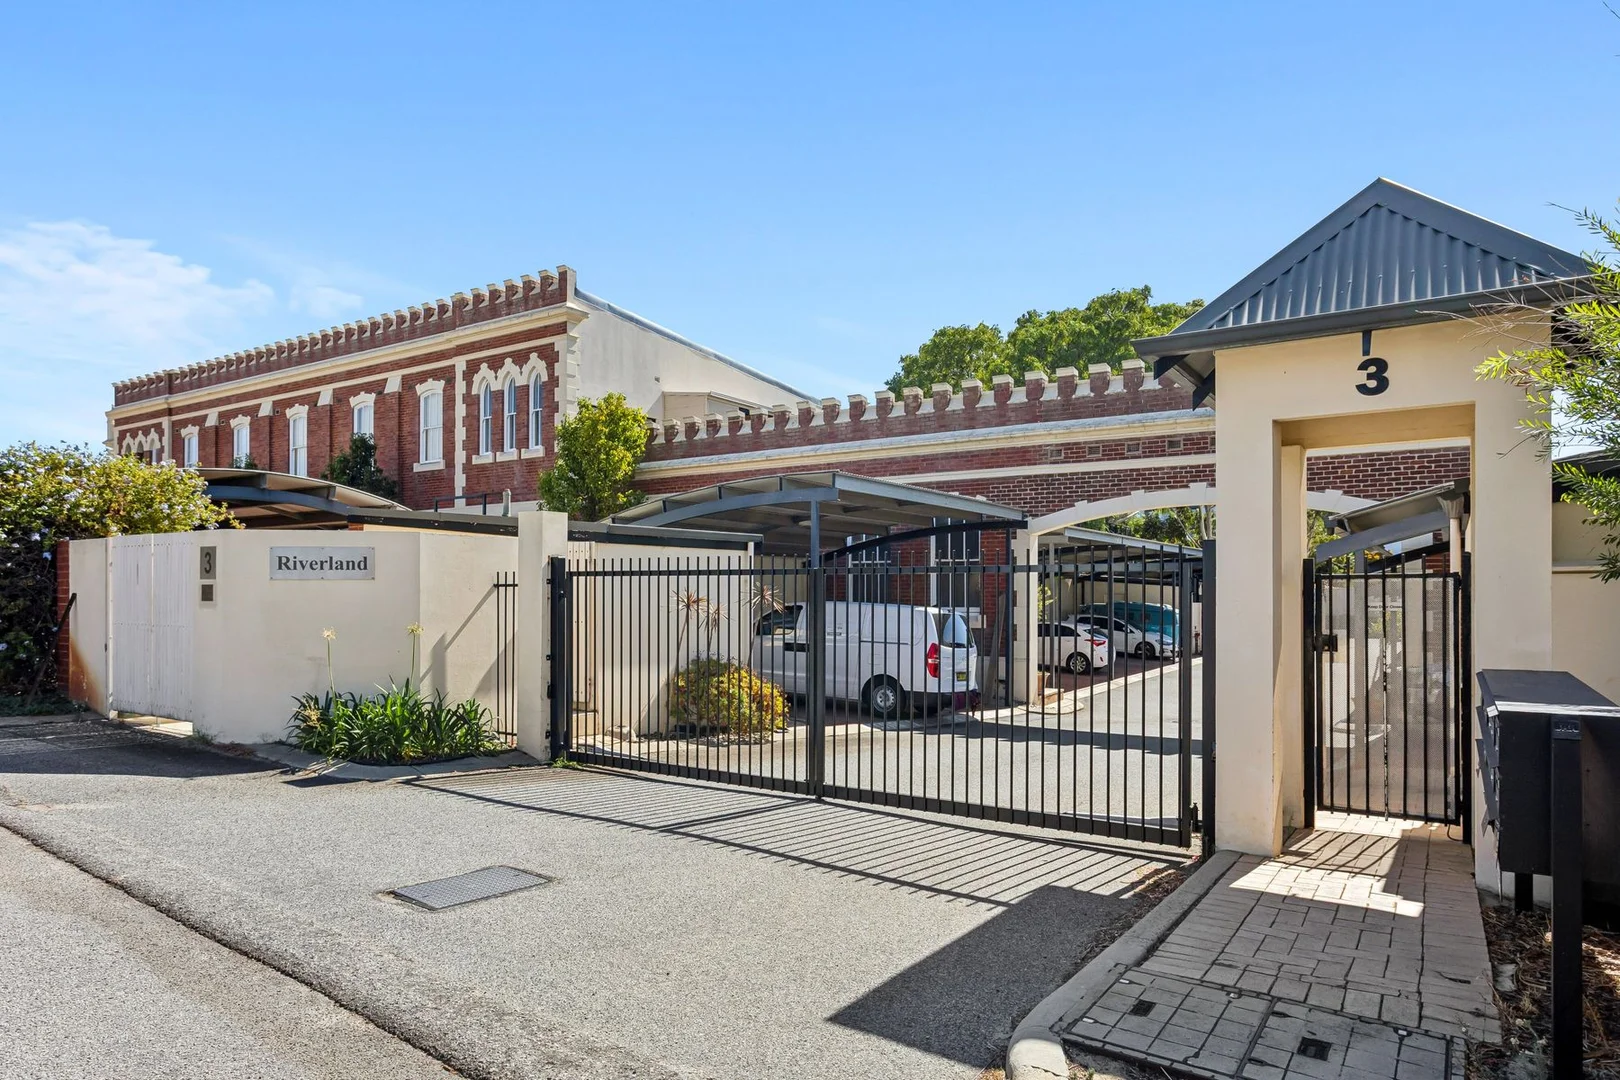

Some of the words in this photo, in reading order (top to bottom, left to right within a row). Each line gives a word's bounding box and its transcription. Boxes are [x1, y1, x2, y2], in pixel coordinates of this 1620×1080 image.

[1355, 357, 1390, 396] 3
[204, 552, 212, 574] 3
[276, 555, 368, 571] Riverland
